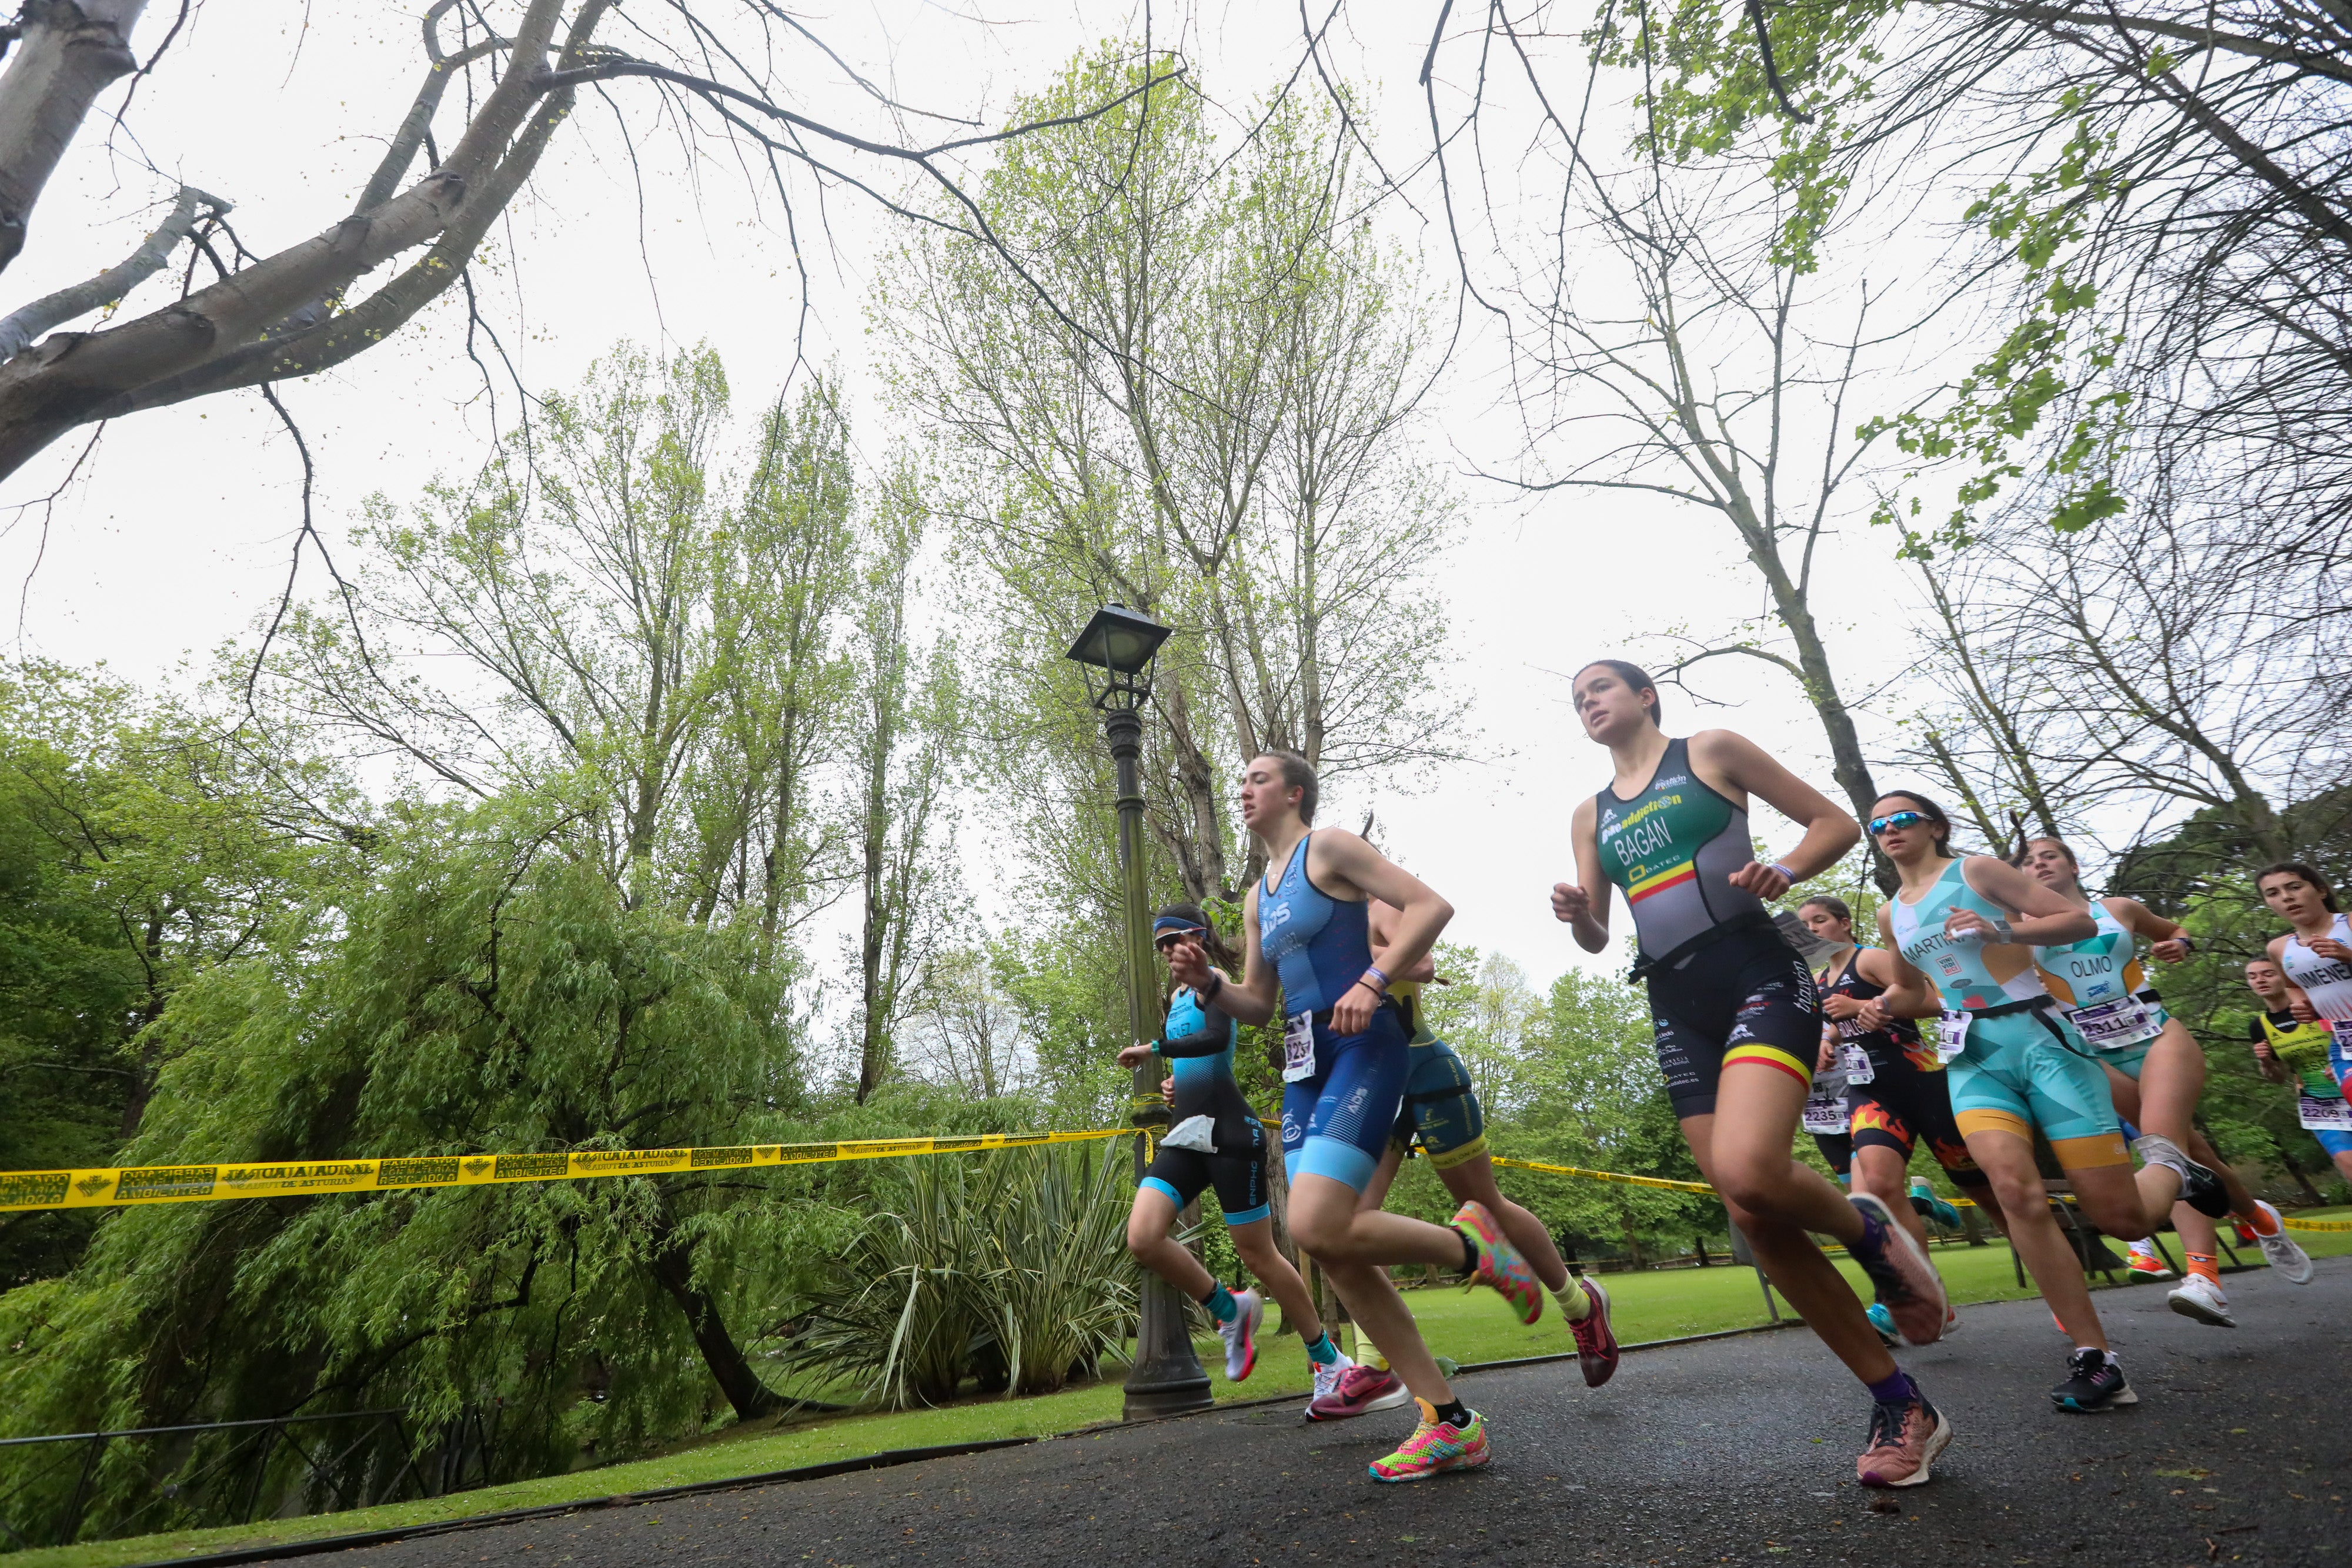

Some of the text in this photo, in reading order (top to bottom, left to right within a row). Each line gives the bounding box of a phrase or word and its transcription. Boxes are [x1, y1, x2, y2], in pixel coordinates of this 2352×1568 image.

[1614, 816, 1672, 866] BAGÁN
[2071, 956, 2112, 977] OLMO
[1805, 1111, 1836, 1121] 2235
